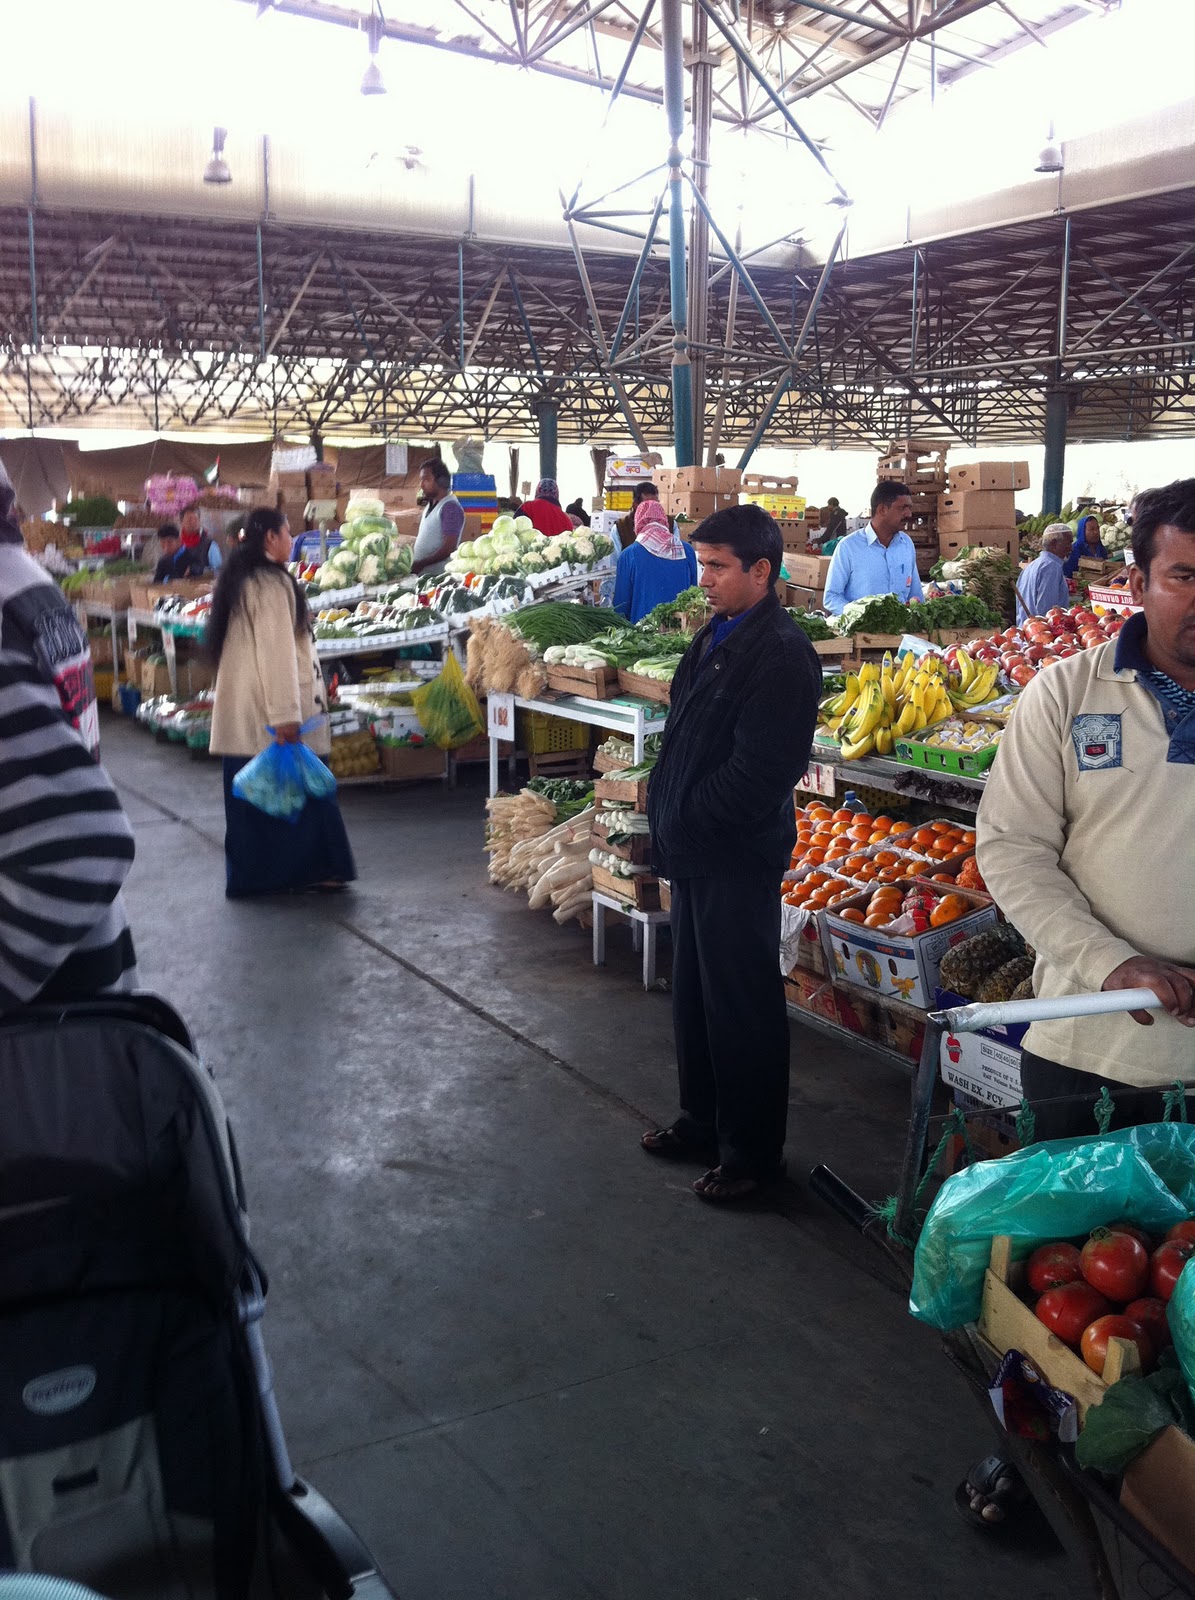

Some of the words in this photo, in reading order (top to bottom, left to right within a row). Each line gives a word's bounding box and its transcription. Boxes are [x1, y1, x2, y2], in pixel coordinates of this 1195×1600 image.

[947, 1071, 969, 1090] WASH
[971, 1083, 985, 1098] EX.
[986, 1090, 1006, 1107] FCY.
